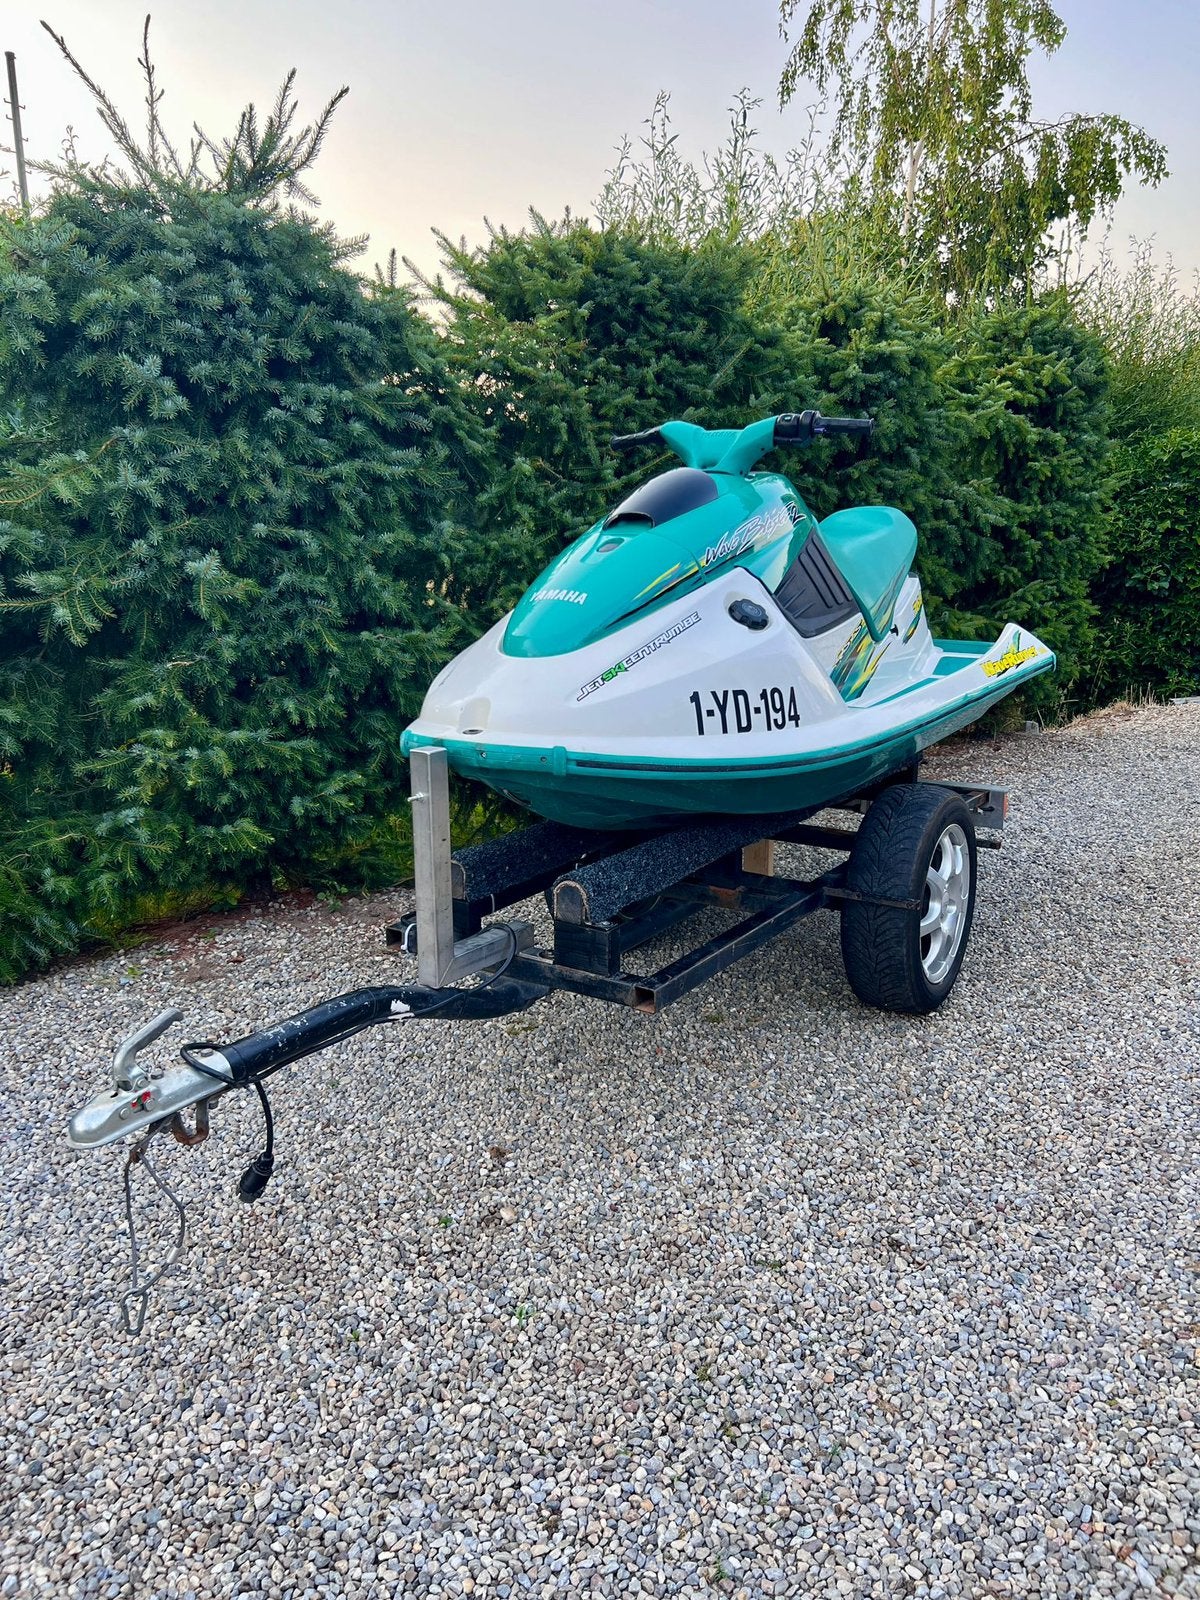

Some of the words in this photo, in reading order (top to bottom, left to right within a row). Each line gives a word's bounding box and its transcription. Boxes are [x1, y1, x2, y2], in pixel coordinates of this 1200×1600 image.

[529, 588, 588, 605] YAMAHA
[576, 611, 703, 701] JETSKICENTRUM.BE
[980, 646, 1038, 678] WaveRunner
[689, 686, 801, 736] 1-YD-194
